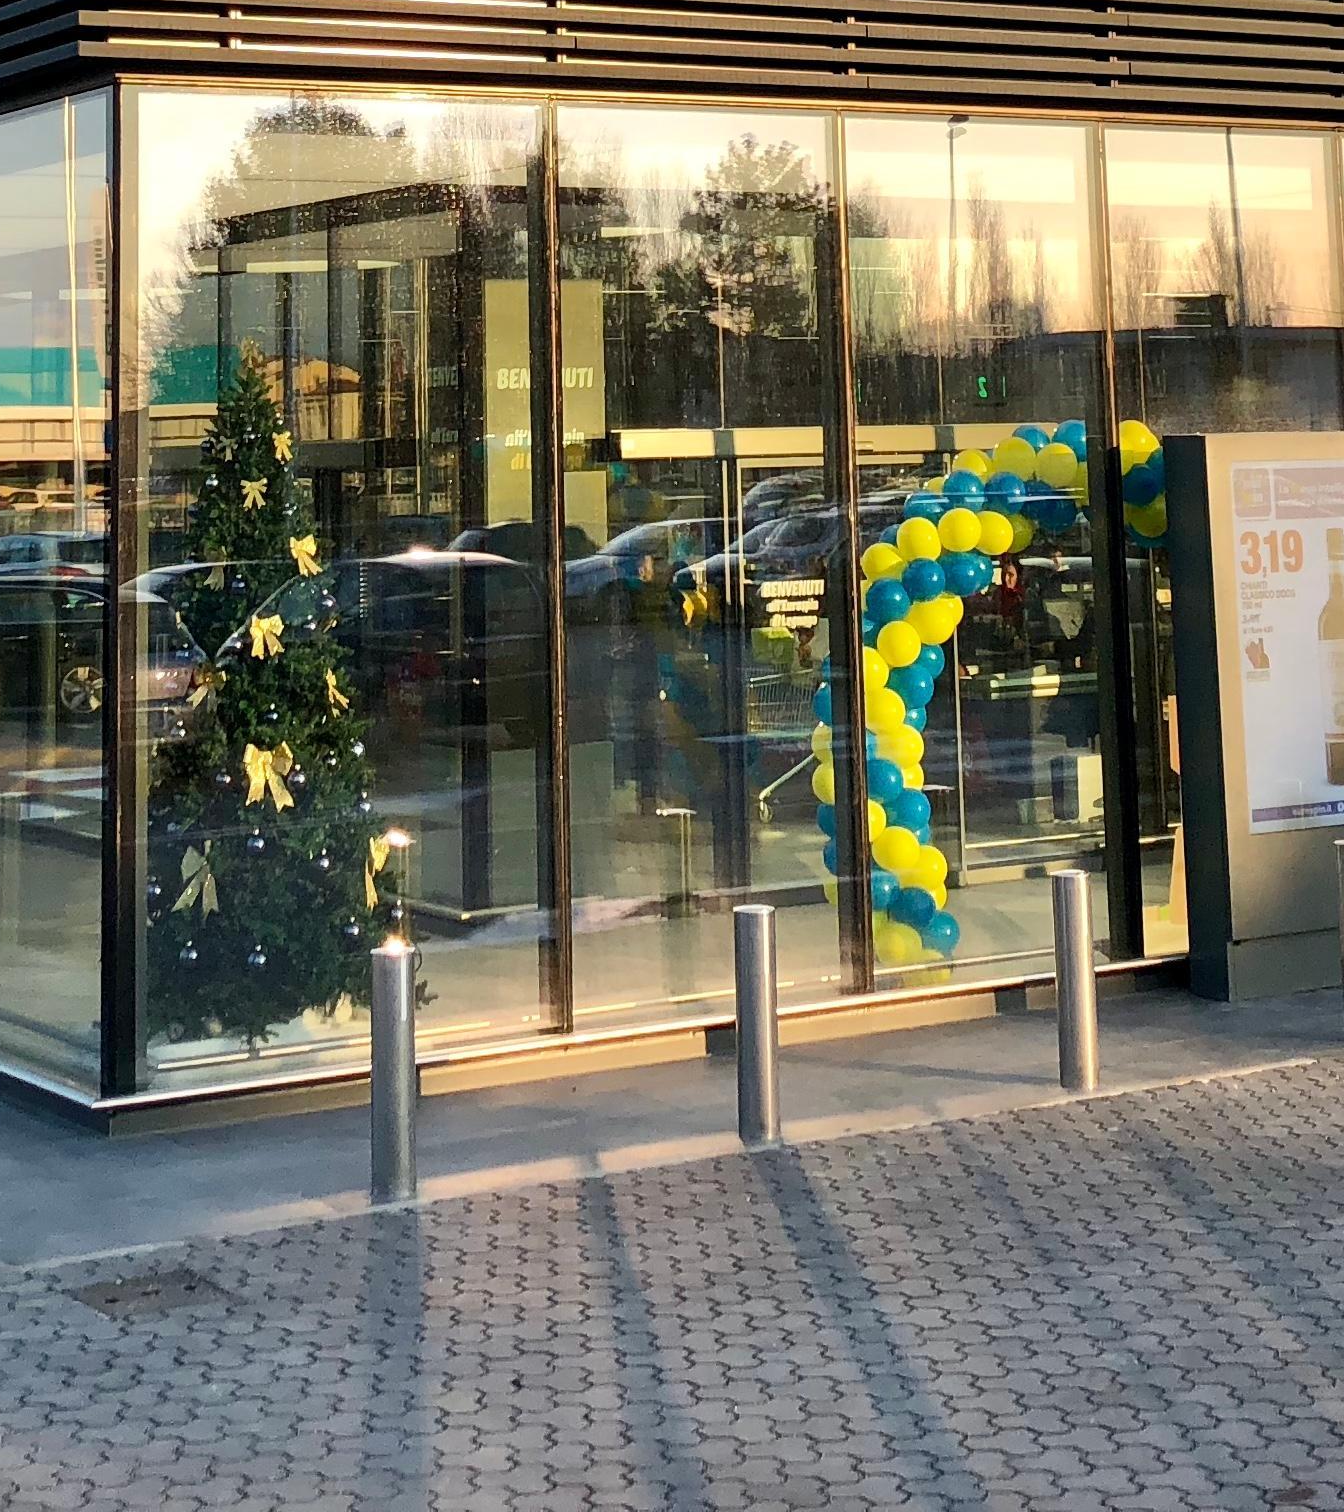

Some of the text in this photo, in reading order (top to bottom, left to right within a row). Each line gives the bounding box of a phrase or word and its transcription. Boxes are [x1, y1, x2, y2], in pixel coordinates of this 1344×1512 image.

[497, 367, 594, 389] BENUTI
[1240, 529, 1304, 578] 3,19
[761, 579, 825, 597] BENVENUTI
